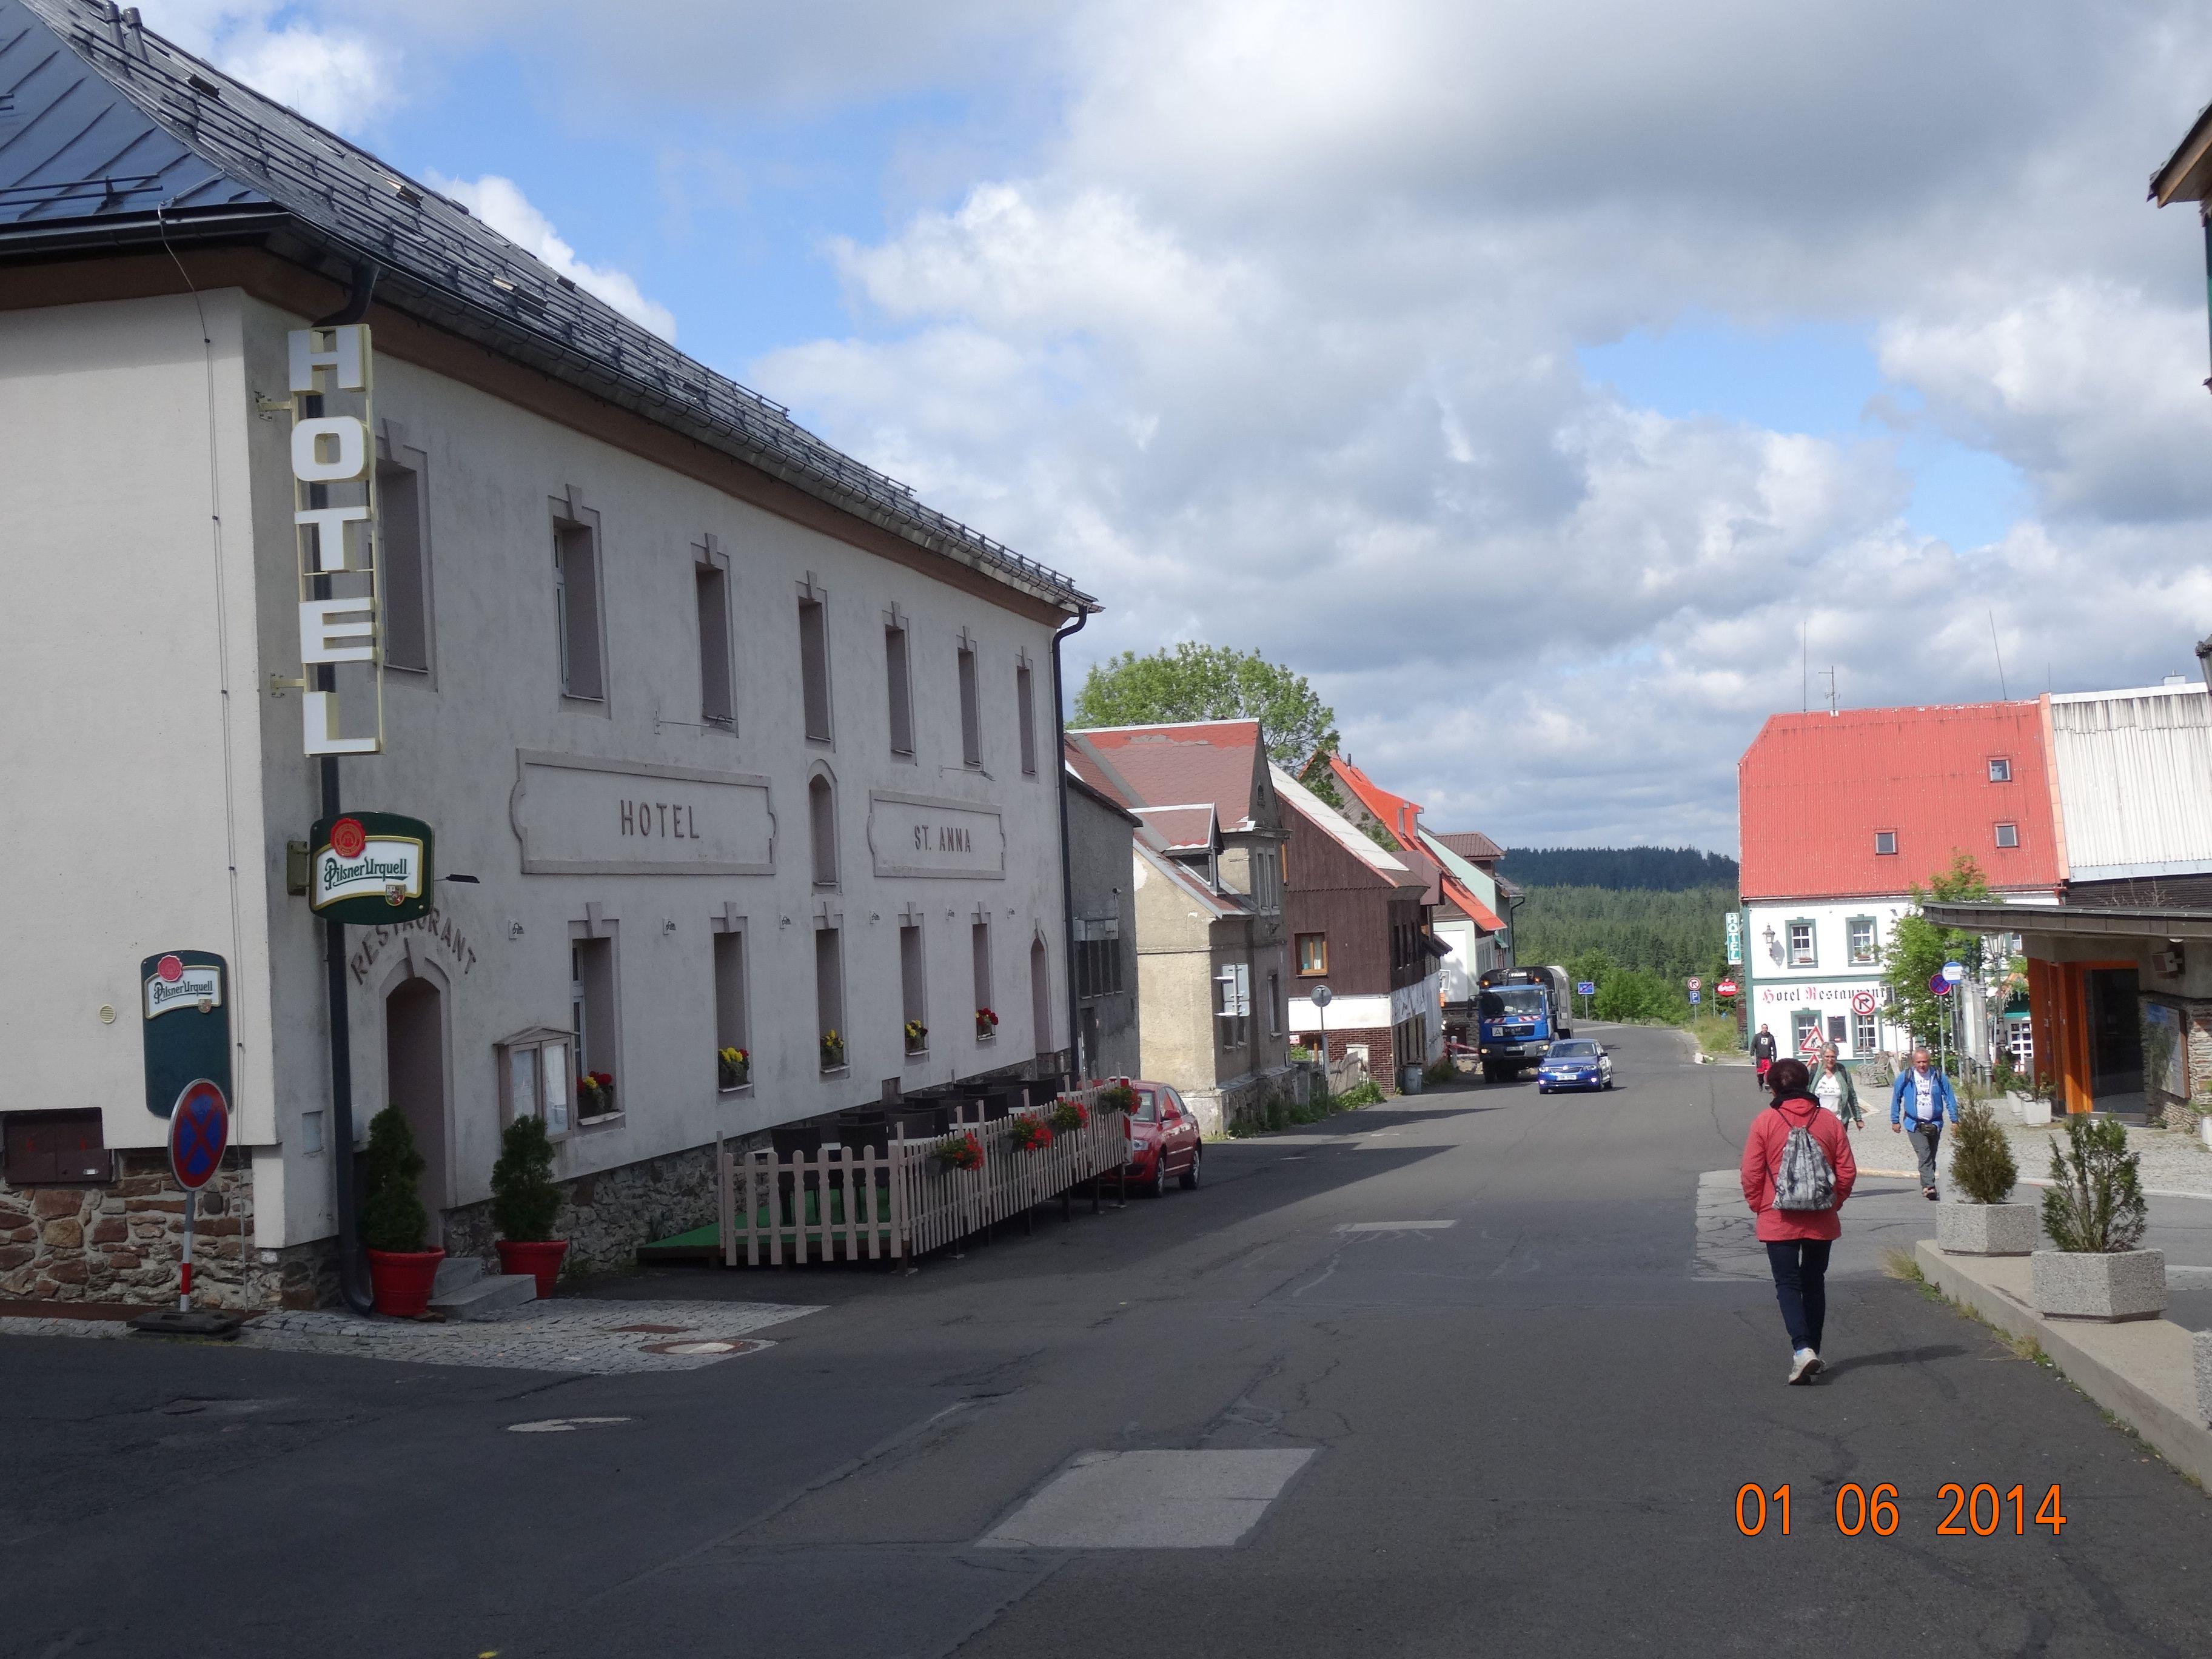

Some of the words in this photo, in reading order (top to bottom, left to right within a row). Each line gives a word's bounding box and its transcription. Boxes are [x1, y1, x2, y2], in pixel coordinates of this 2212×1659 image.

[288, 324, 380, 754] HOTEL
[620, 800, 700, 839] HOTEL
[914, 825, 931, 850] ST.
[939, 826, 971, 853] ANNA
[324, 857, 365, 891] Pilsner
[364, 856, 407, 882] Urquell
[1726, 914, 1739, 960] HOTEL
[153, 982, 184, 1004] Pilsner
[183, 980, 212, 996] Urquell
[1763, 987, 1800, 1004] Hotel
[1805, 987, 1885, 1001] Restaunt
